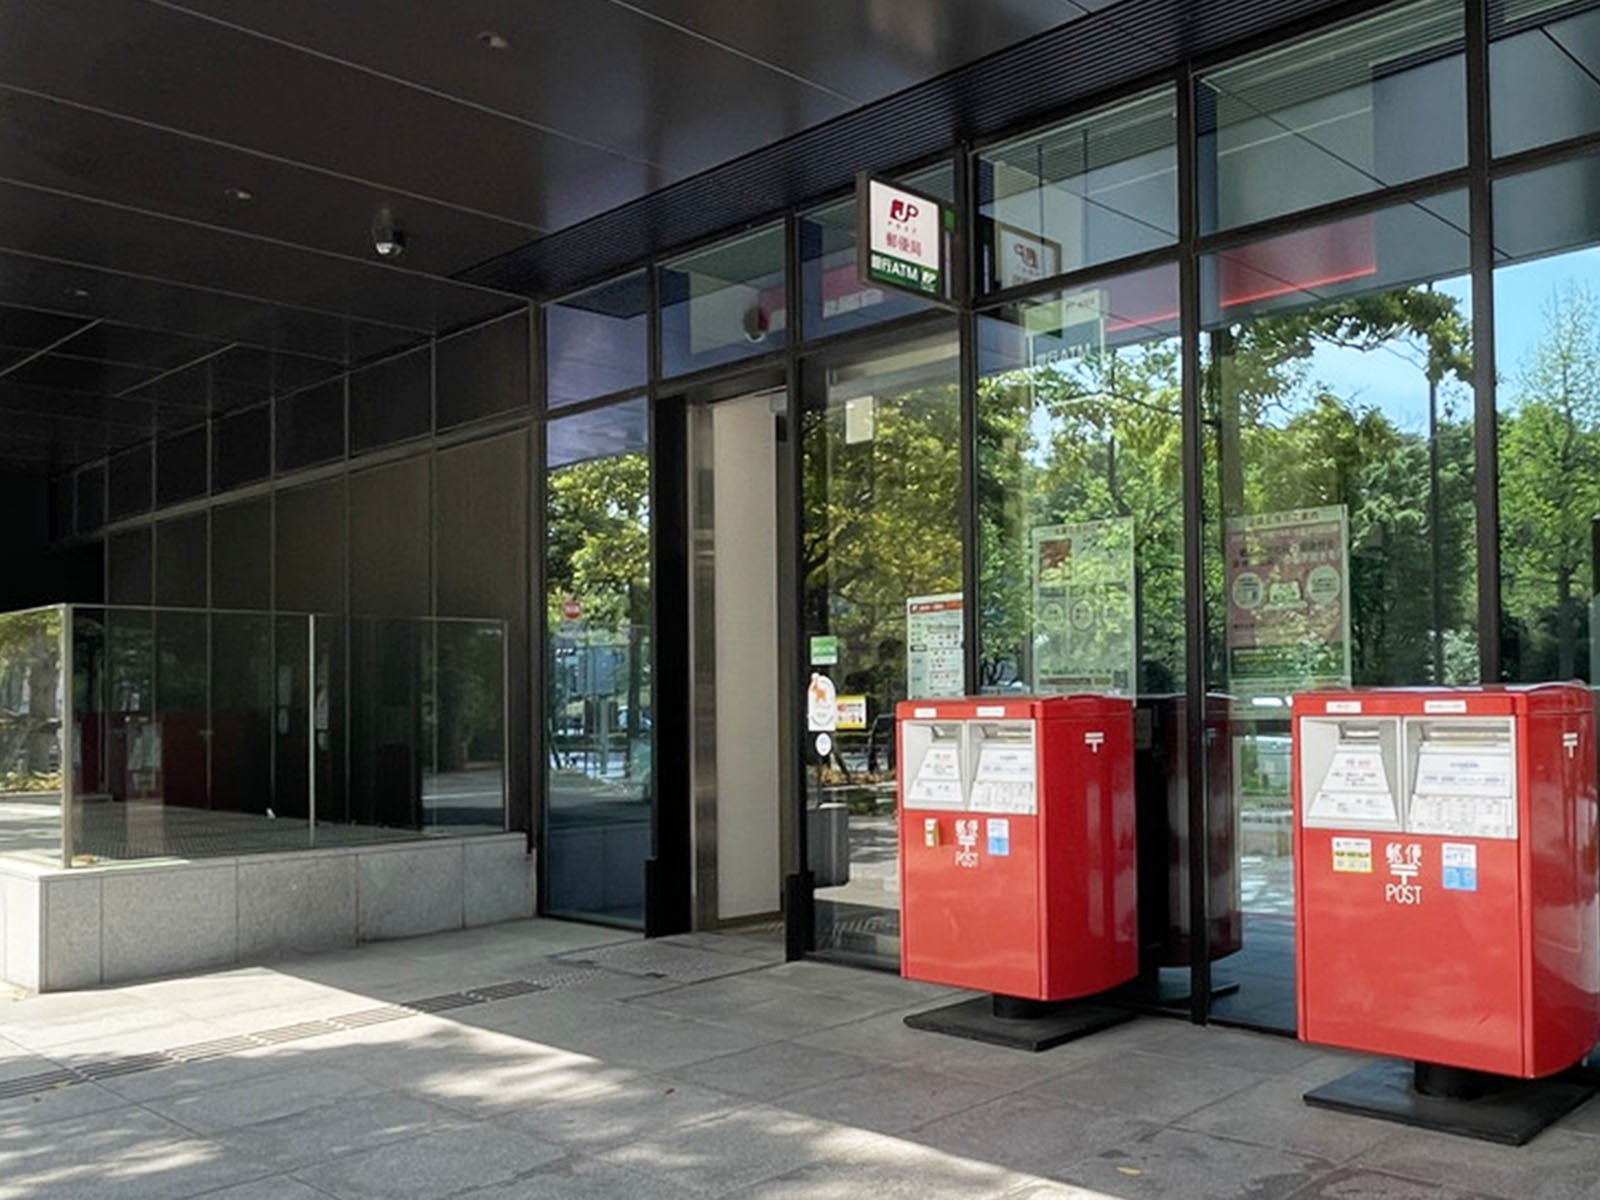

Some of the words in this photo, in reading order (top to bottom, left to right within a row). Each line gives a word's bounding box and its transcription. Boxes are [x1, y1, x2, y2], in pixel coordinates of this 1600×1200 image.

[886, 232, 922, 256] 郵便局
[955, 852, 978, 868] POST
[1385, 842, 1423, 867] 郵便
[1385, 883, 1423, 905] POST
